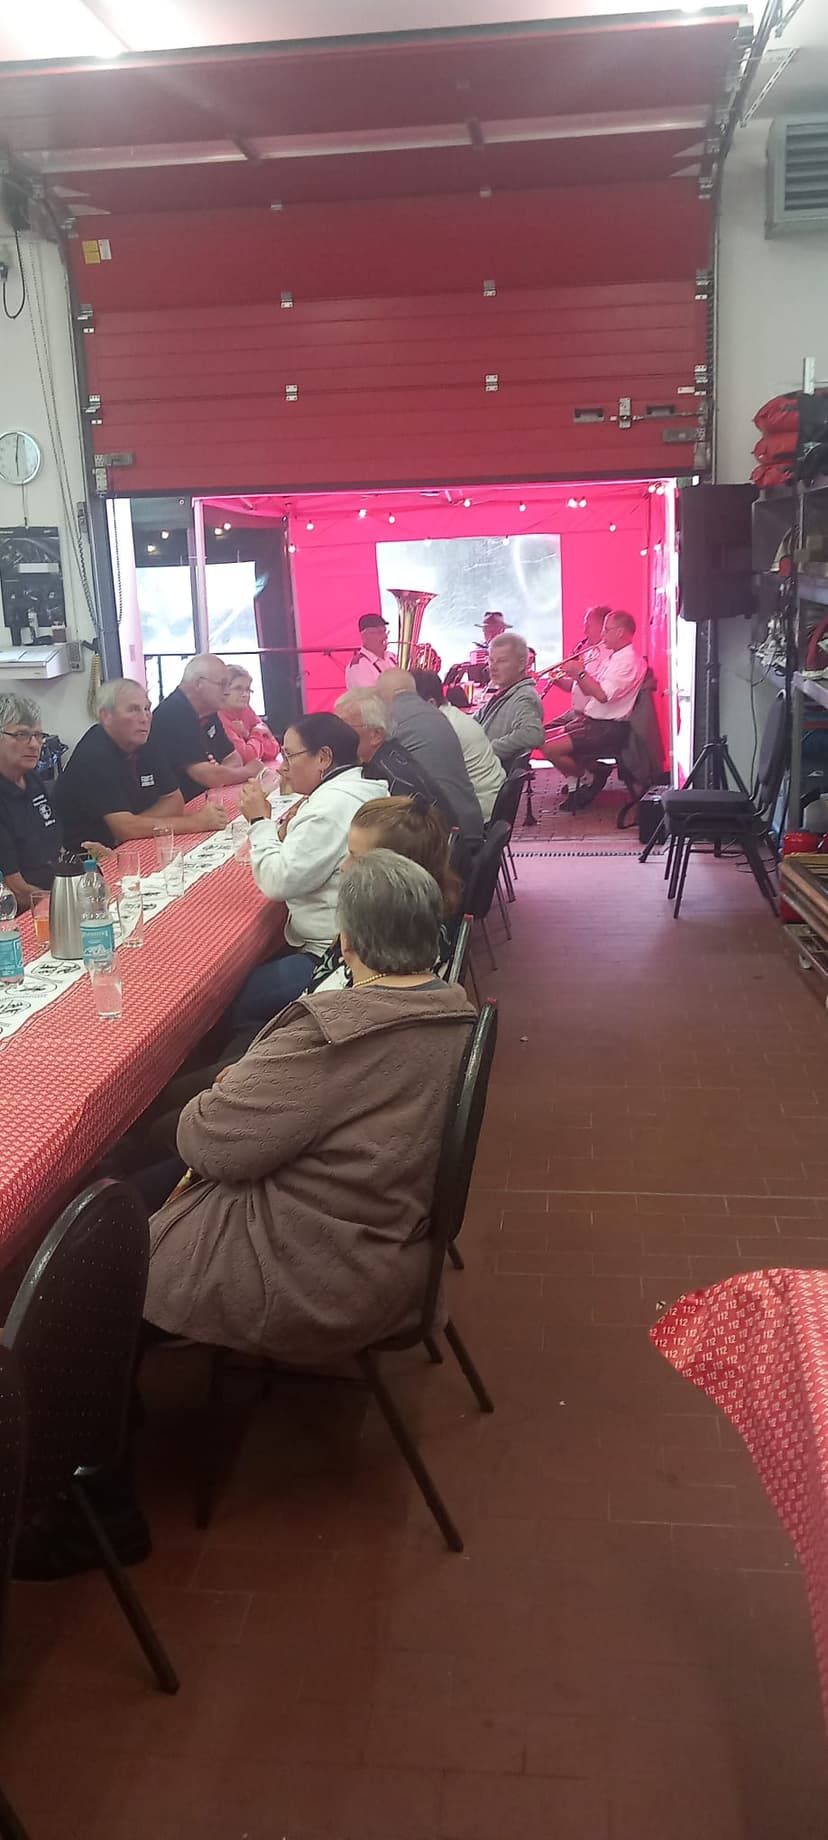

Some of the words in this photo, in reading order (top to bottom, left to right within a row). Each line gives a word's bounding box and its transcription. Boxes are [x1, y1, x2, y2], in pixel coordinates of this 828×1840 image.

[752, 1270, 763, 1279] 112
[726, 1300, 737, 1310] 112
[683, 1306, 696, 1314] 112
[764, 1309, 775, 1318] 112
[718, 1311, 729, 1321] 112
[675, 1318, 688, 1326] 112
[728, 1320, 740, 1329] 112
[686, 1329, 697, 1337] 112
[713, 1326, 724, 1336] 112
[763, 1329, 775, 1339] 112
[655, 1339, 667, 1347] 112
[673, 1337, 686, 1346] 112
[706, 1337, 716, 1347] 112
[724, 1335, 736, 1344] 112
[716, 1346, 727, 1356] 112
[736, 1343, 745, 1354] 112
[665, 1350, 678, 1358] 112
[703, 1352, 712, 1361] 112
[726, 1355, 738, 1365] 112
[696, 1363, 706, 1371] 112
[713, 1361, 724, 1370] 112
[756, 1365, 766, 1374] 112
[682, 1369, 693, 1377] 112
[707, 1371, 717, 1380] 112
[725, 1370, 735, 1379] 112
[693, 1377, 705, 1385] 112
[718, 1380, 728, 1389] 112
[705, 1386, 715, 1395] 112
[728, 1390, 737, 1399] 112
[715, 1395, 725, 1404] 112
[724, 1405, 733, 1414] 112
[731, 1414, 740, 1424] 112
